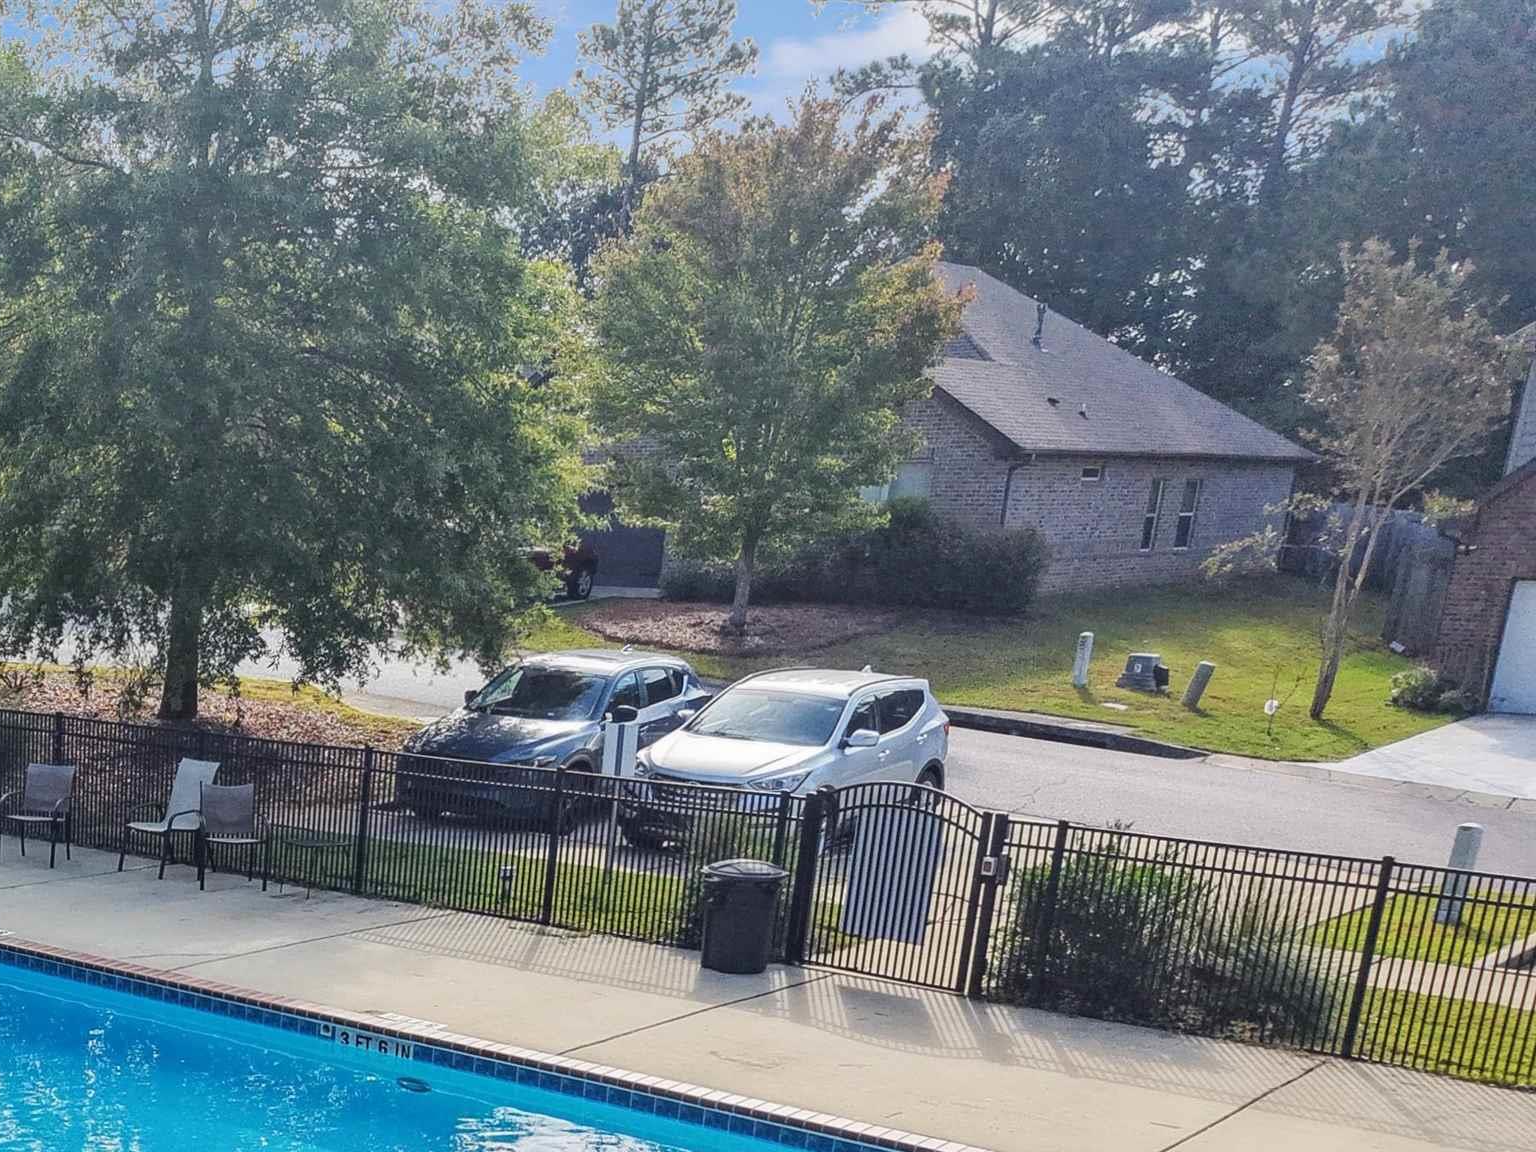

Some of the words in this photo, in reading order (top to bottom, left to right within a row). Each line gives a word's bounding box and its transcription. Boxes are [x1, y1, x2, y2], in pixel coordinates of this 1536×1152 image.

[340, 1031, 350, 1045] 3
[355, 1035, 372, 1050] FT
[378, 1040, 388, 1053] 6
[395, 1042, 410, 1059] IN
